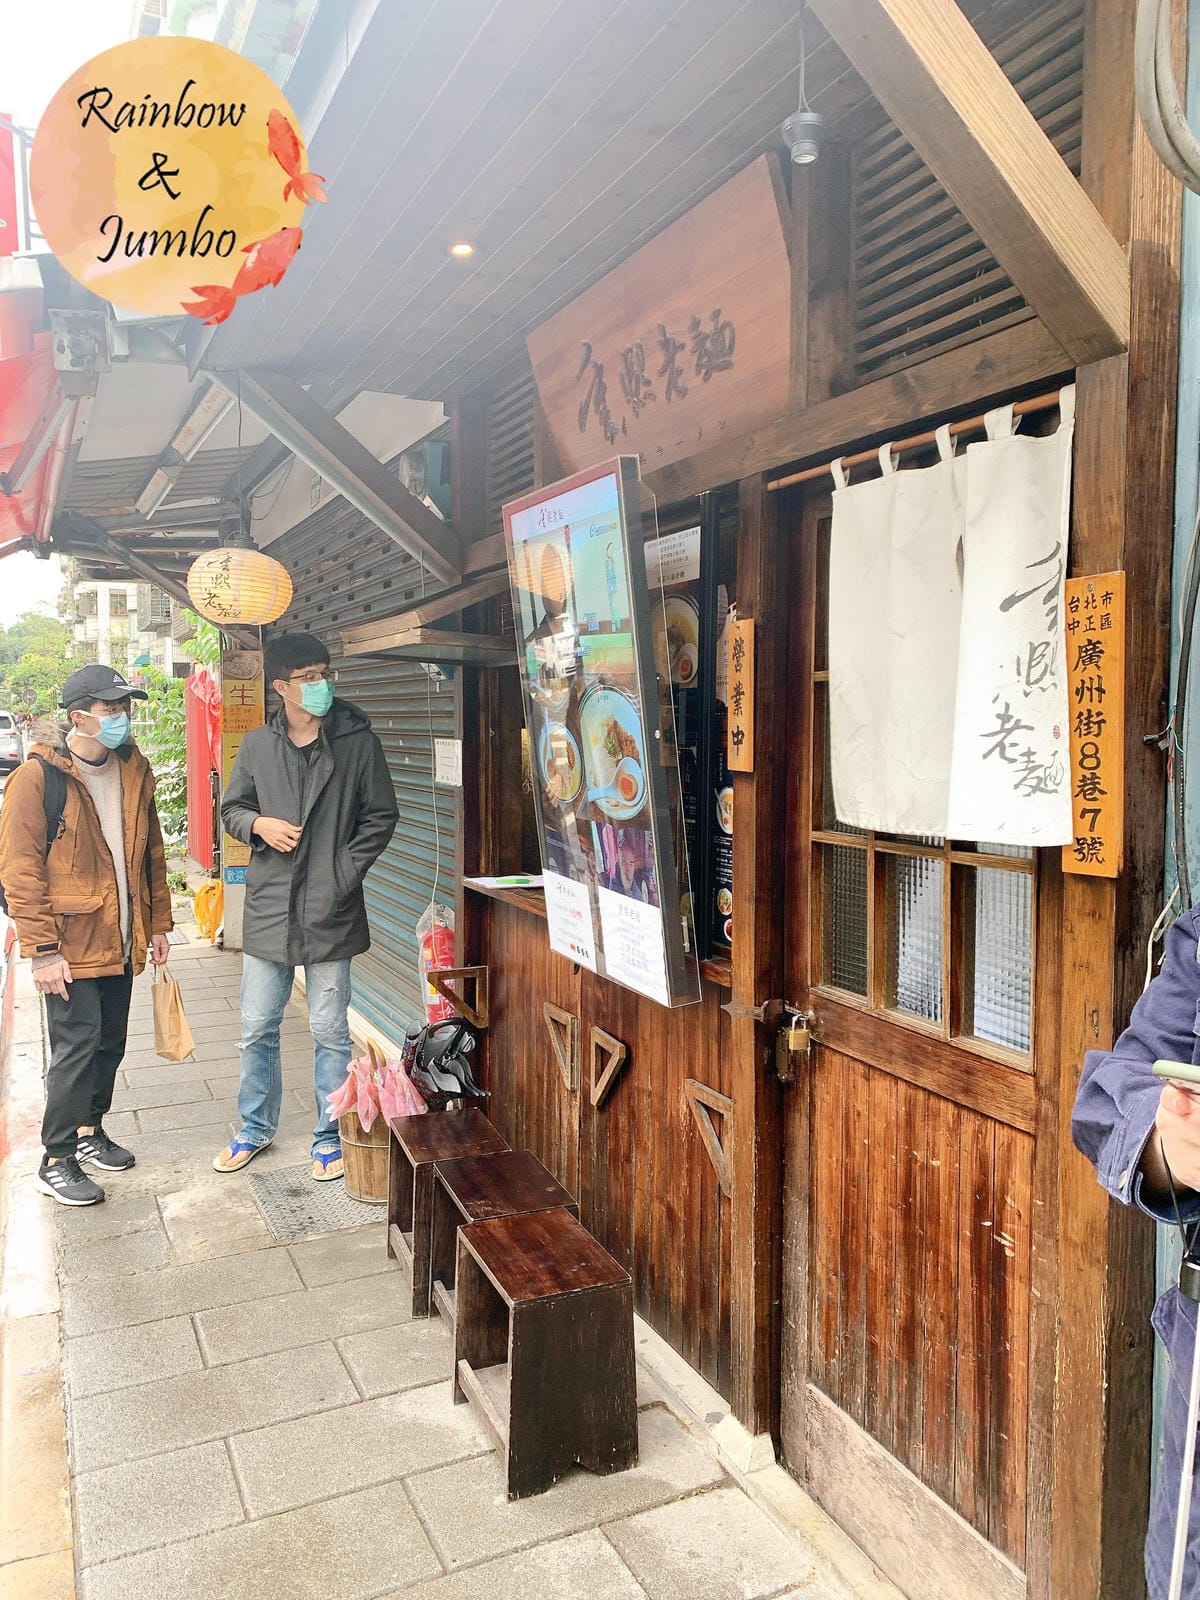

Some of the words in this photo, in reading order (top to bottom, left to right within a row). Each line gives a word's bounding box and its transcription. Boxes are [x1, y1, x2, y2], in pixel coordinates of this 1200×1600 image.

[1067, 613, 1113, 635] 中正區
[1068, 590, 1114, 614] 台北市
[731, 637, 746, 756] 營業中
[1072, 638, 1107, 865] 廣州街8巷7號
